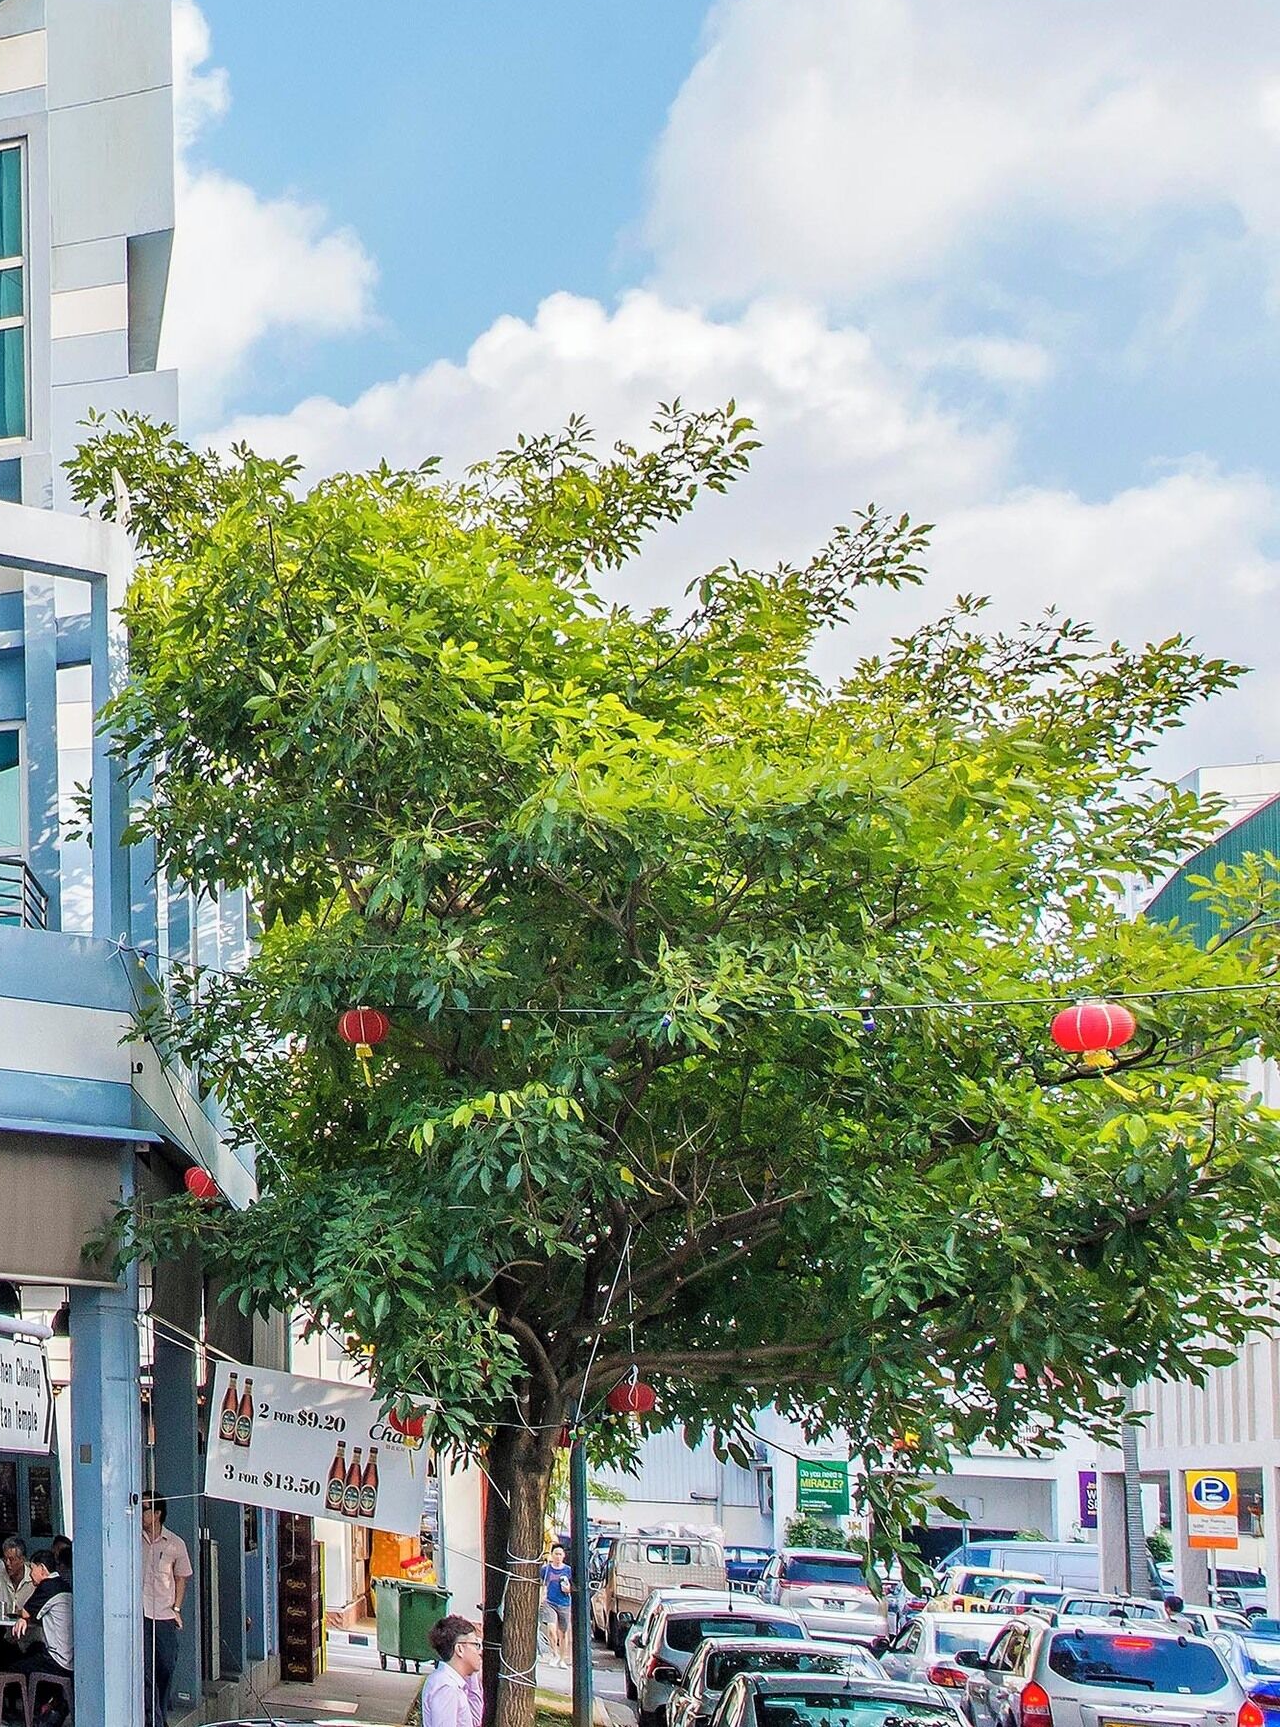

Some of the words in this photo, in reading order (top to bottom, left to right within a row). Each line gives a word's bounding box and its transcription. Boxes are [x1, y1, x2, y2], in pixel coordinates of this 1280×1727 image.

[15, 1400, 38, 1439] Temple
[258, 1402, 270, 1419] 2
[273, 1411, 294, 1424] FOR
[297, 1409, 346, 1433] $9.20
[369, 1424, 424, 1451] Chag
[224, 1463, 235, 1480] 3
[239, 1472, 259, 1485] FOR
[263, 1471, 321, 1497] $13.50
[801, 1478, 844, 1489] MIRACLE?
